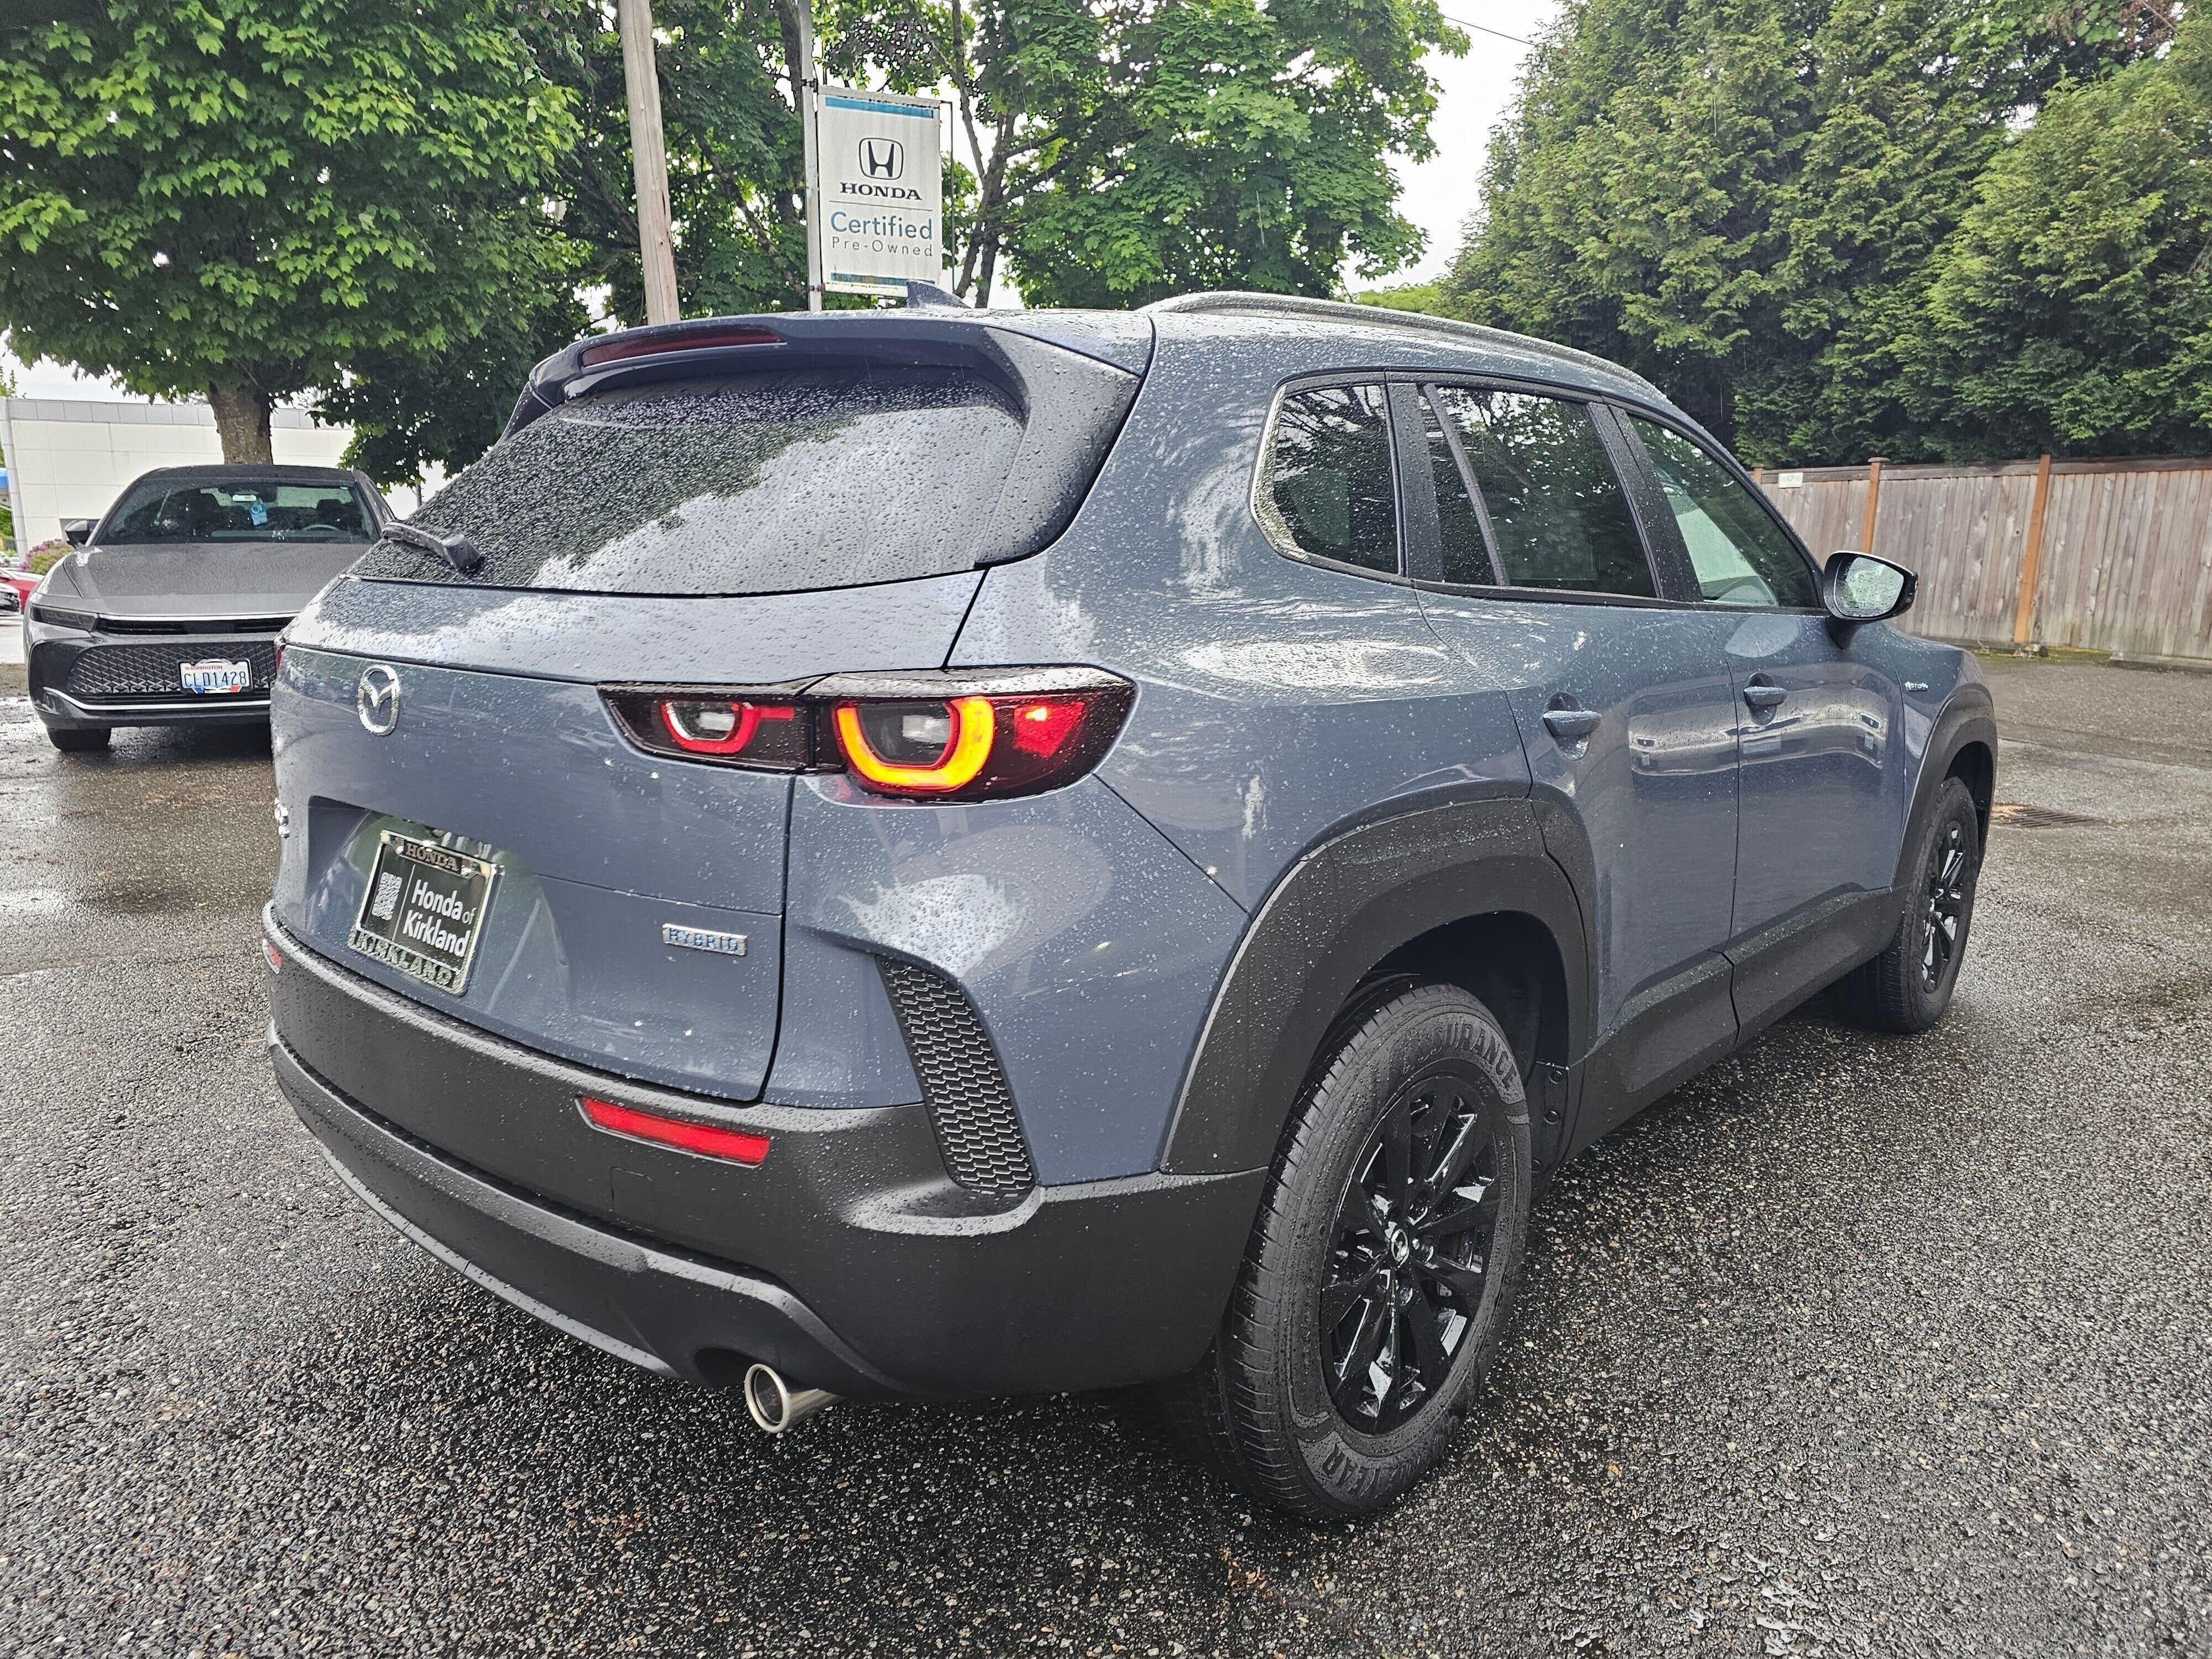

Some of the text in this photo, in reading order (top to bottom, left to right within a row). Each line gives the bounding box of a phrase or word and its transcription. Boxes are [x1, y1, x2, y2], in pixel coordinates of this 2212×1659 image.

[839, 182, 922, 200] HONDA
[831, 212, 933, 240] Certified
[832, 236, 933, 257] Pre-Owned
[184, 671, 247, 687] CLD1428
[405, 842, 460, 872] HONDA
[411, 879, 477, 925] Honda of
[403, 909, 471, 958] Kirkland
[670, 929, 739, 952] HYBRID
[357, 931, 452, 985] KIRKLAND
[1402, 1022, 1517, 1091] SURANCE
